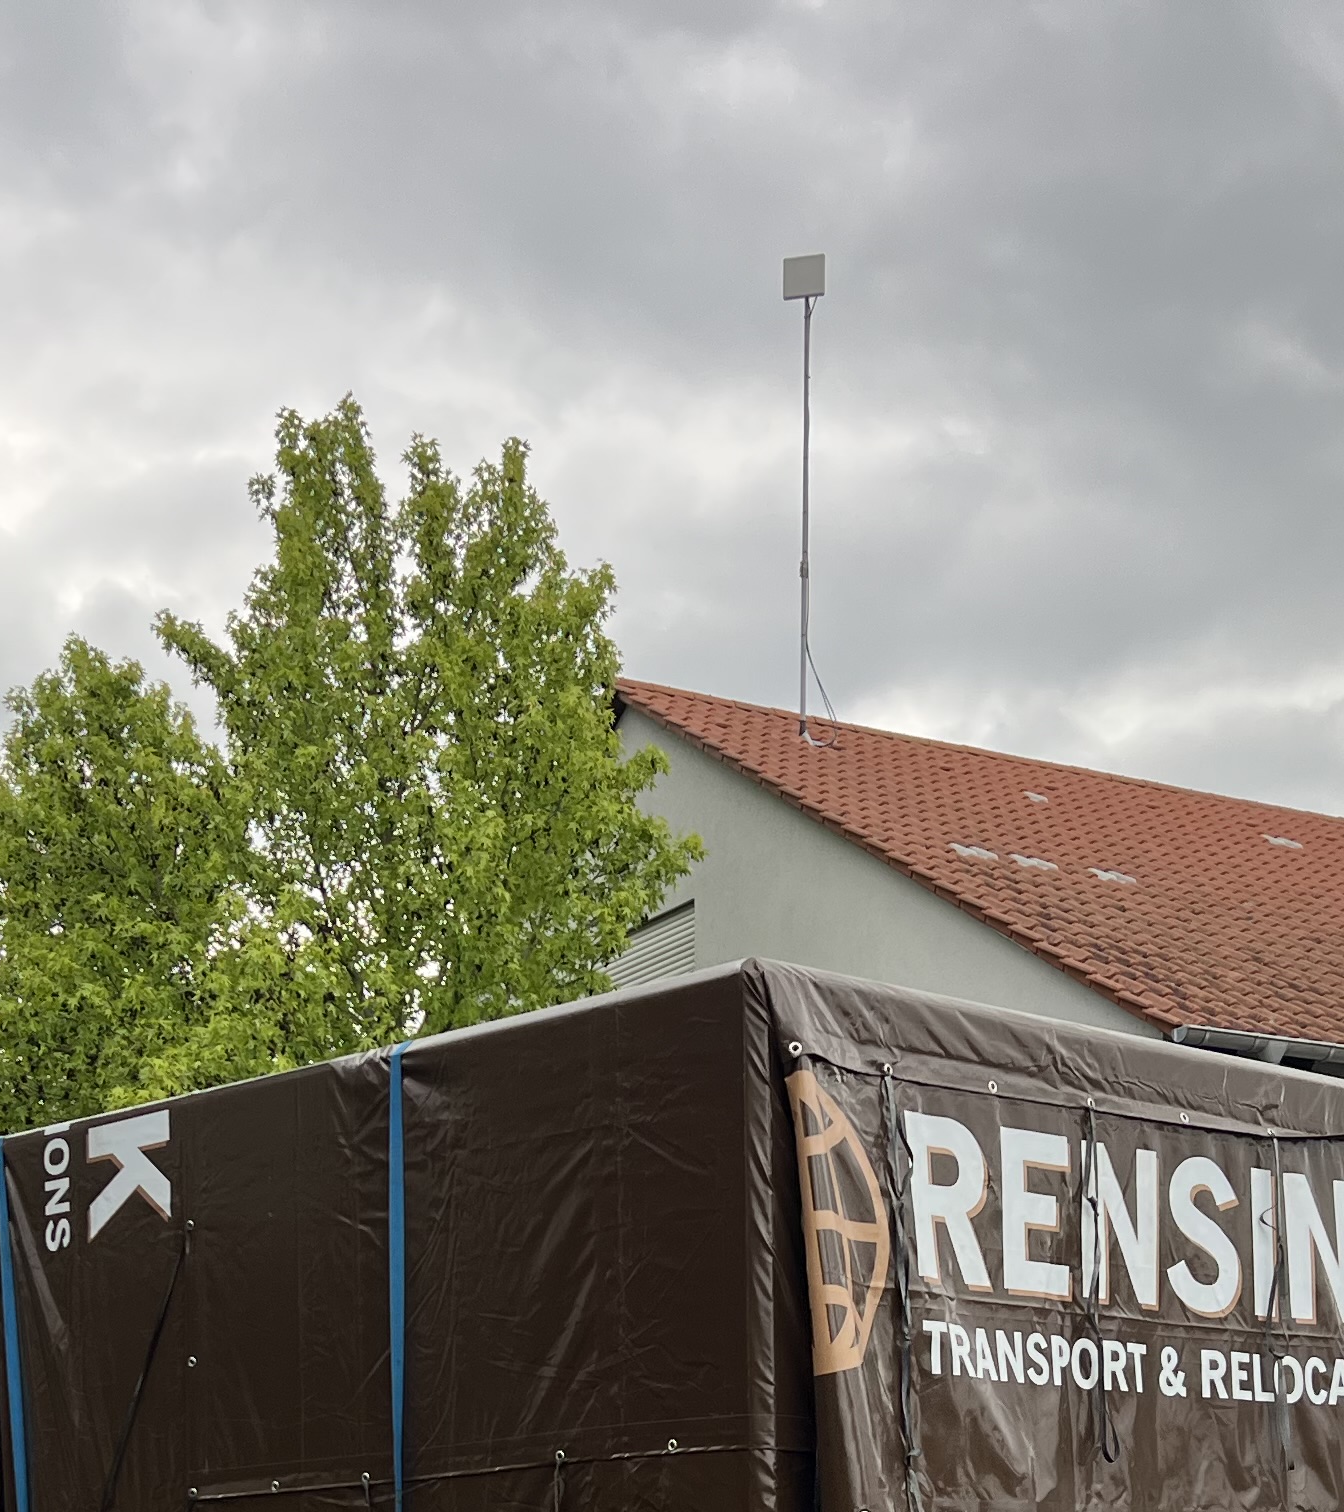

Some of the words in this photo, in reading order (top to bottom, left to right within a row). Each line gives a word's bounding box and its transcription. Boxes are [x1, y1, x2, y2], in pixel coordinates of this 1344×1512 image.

[86, 1109, 172, 1243] K
[922, 1319, 1147, 1394] TRANSPORT
[1159, 1346, 1187, 1400] &
